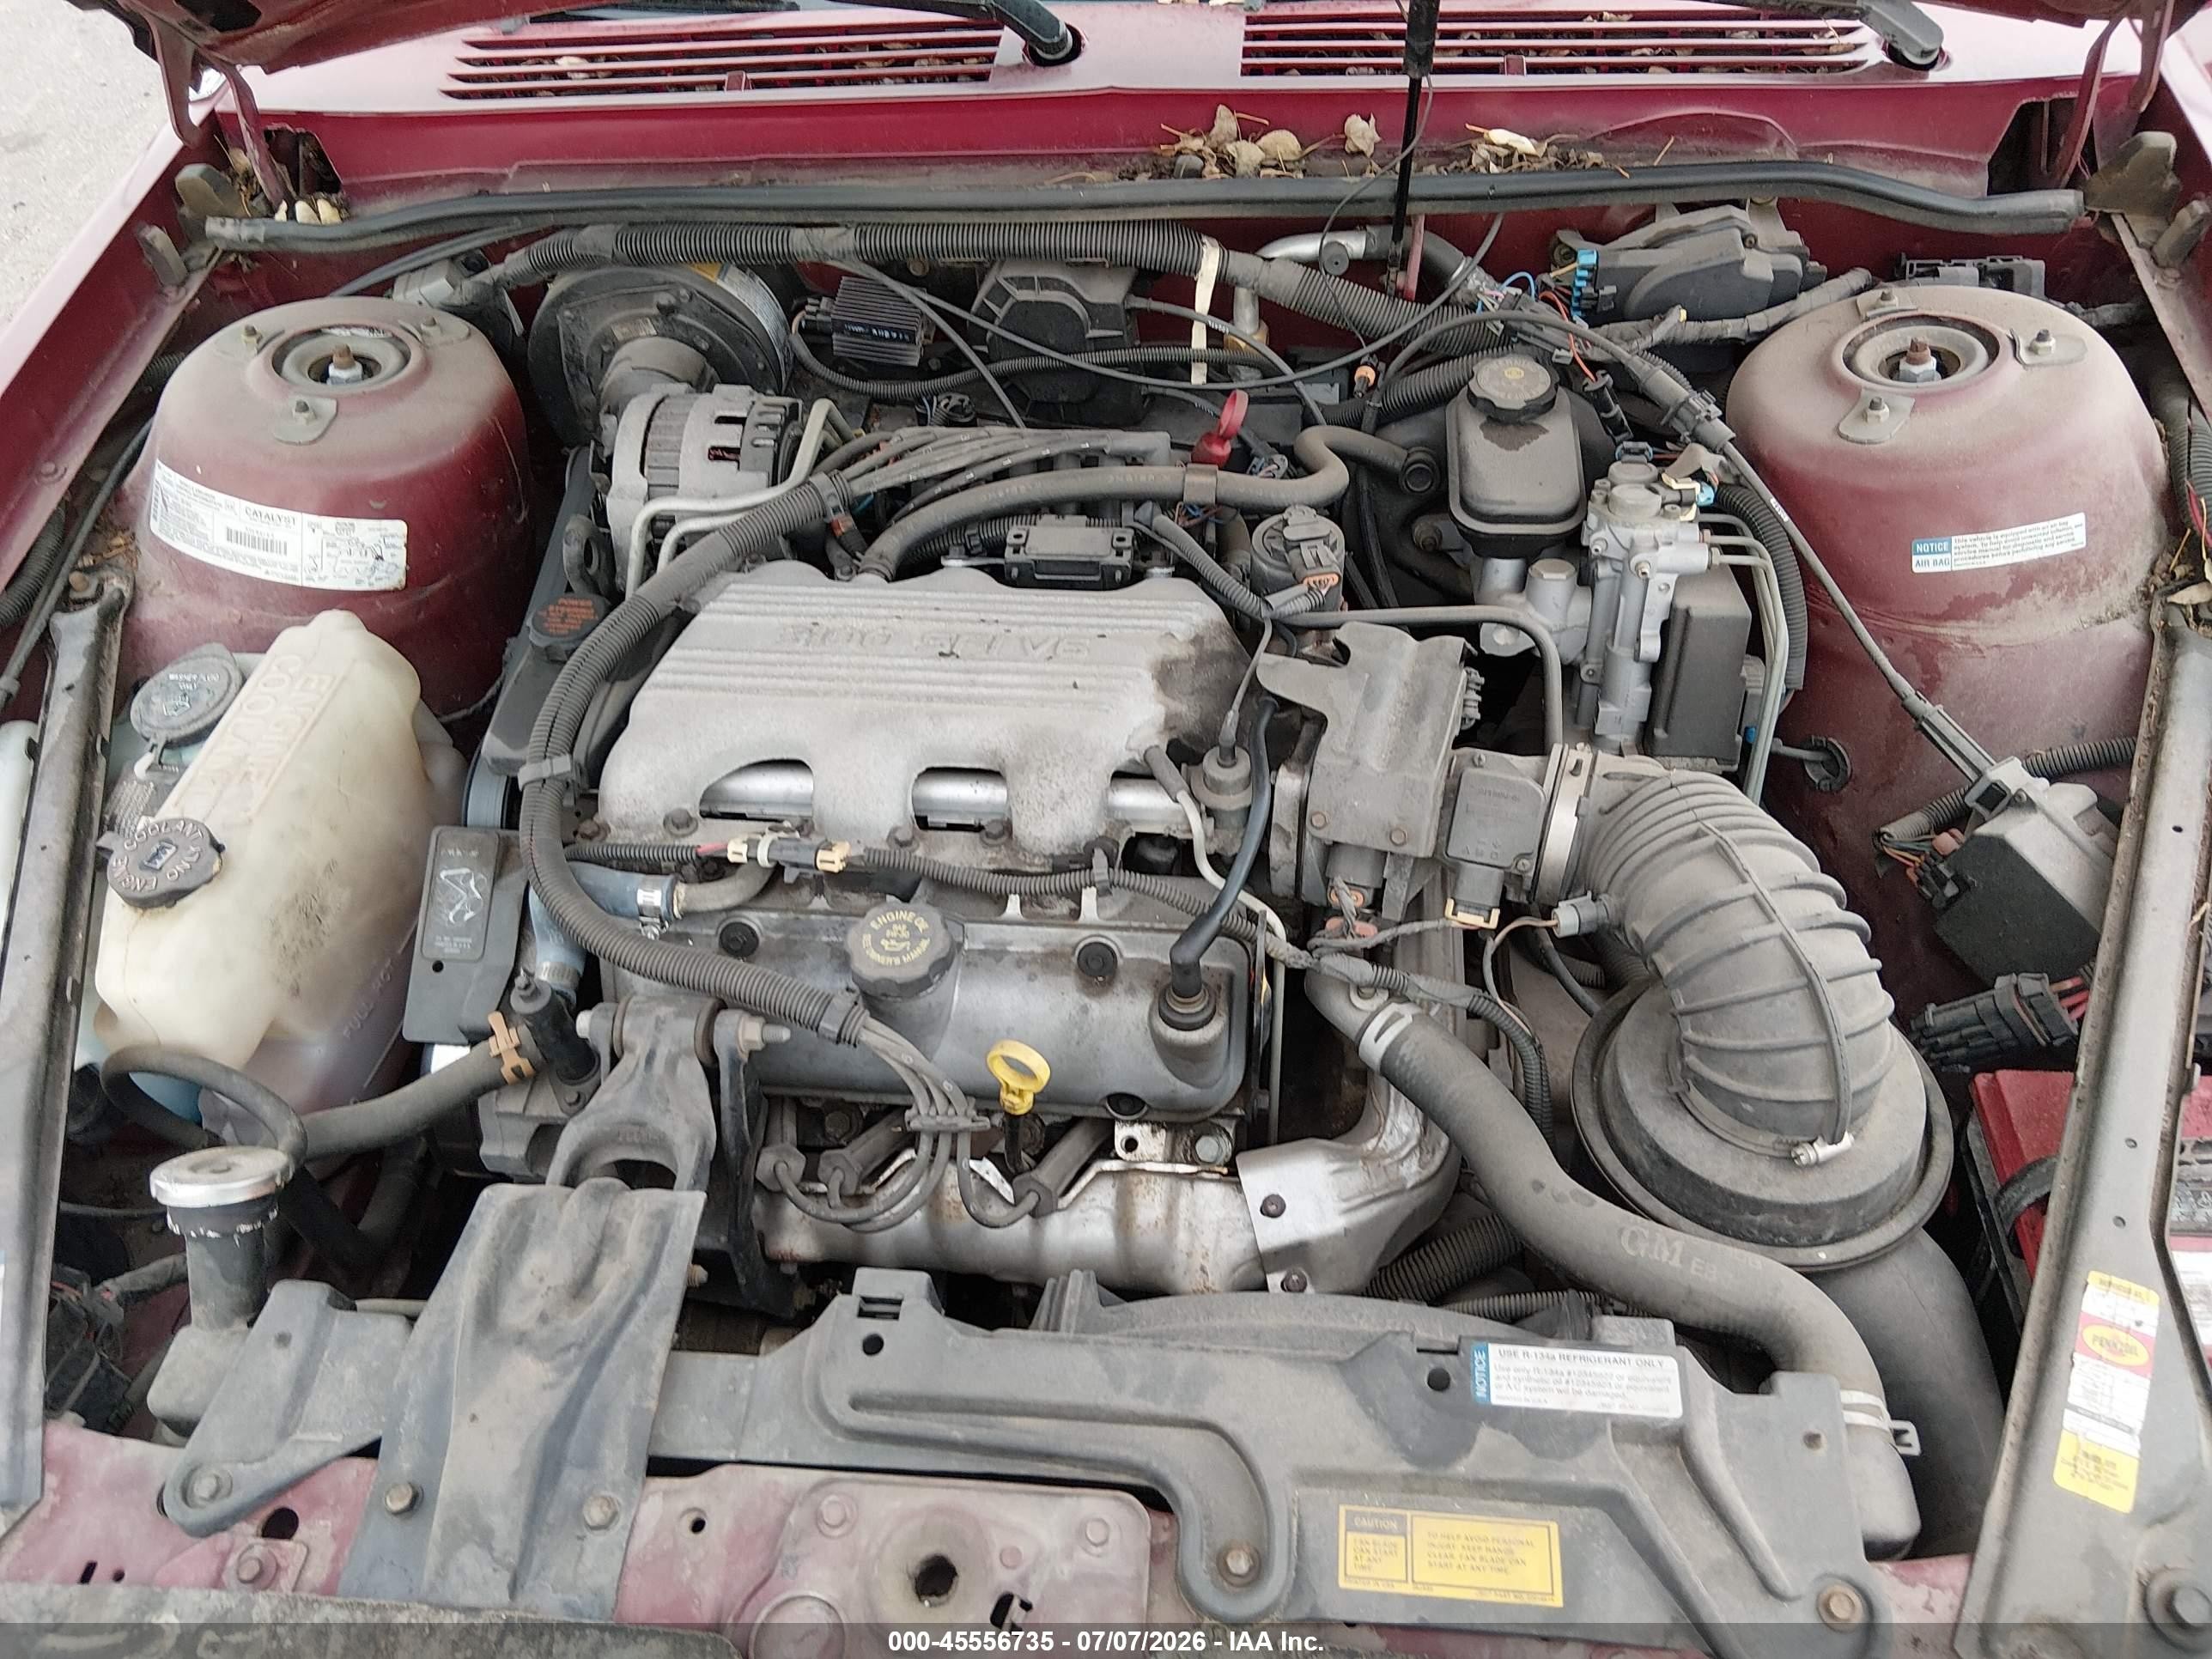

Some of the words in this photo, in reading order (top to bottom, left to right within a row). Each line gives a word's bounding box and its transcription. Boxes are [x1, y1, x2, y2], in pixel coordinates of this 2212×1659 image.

[245, 506, 297, 526] CATALYST
[1916, 542, 1948, 553] NOTICE
[1915, 558, 1930, 568] AIR
[123, 819, 204, 852] COOLANT
[870, 910, 915, 930] ENGINE
[1620, 1224, 1686, 1269] GM
[1498, 1349, 1519, 1358] USE
[1558, 1352, 1632, 1367] REFRIGERANT
[1636, 1358, 1665, 1368] ONLY
[1474, 1350, 1487, 1398] NOTICE
[1354, 1517, 1398, 1530] CAUTION
